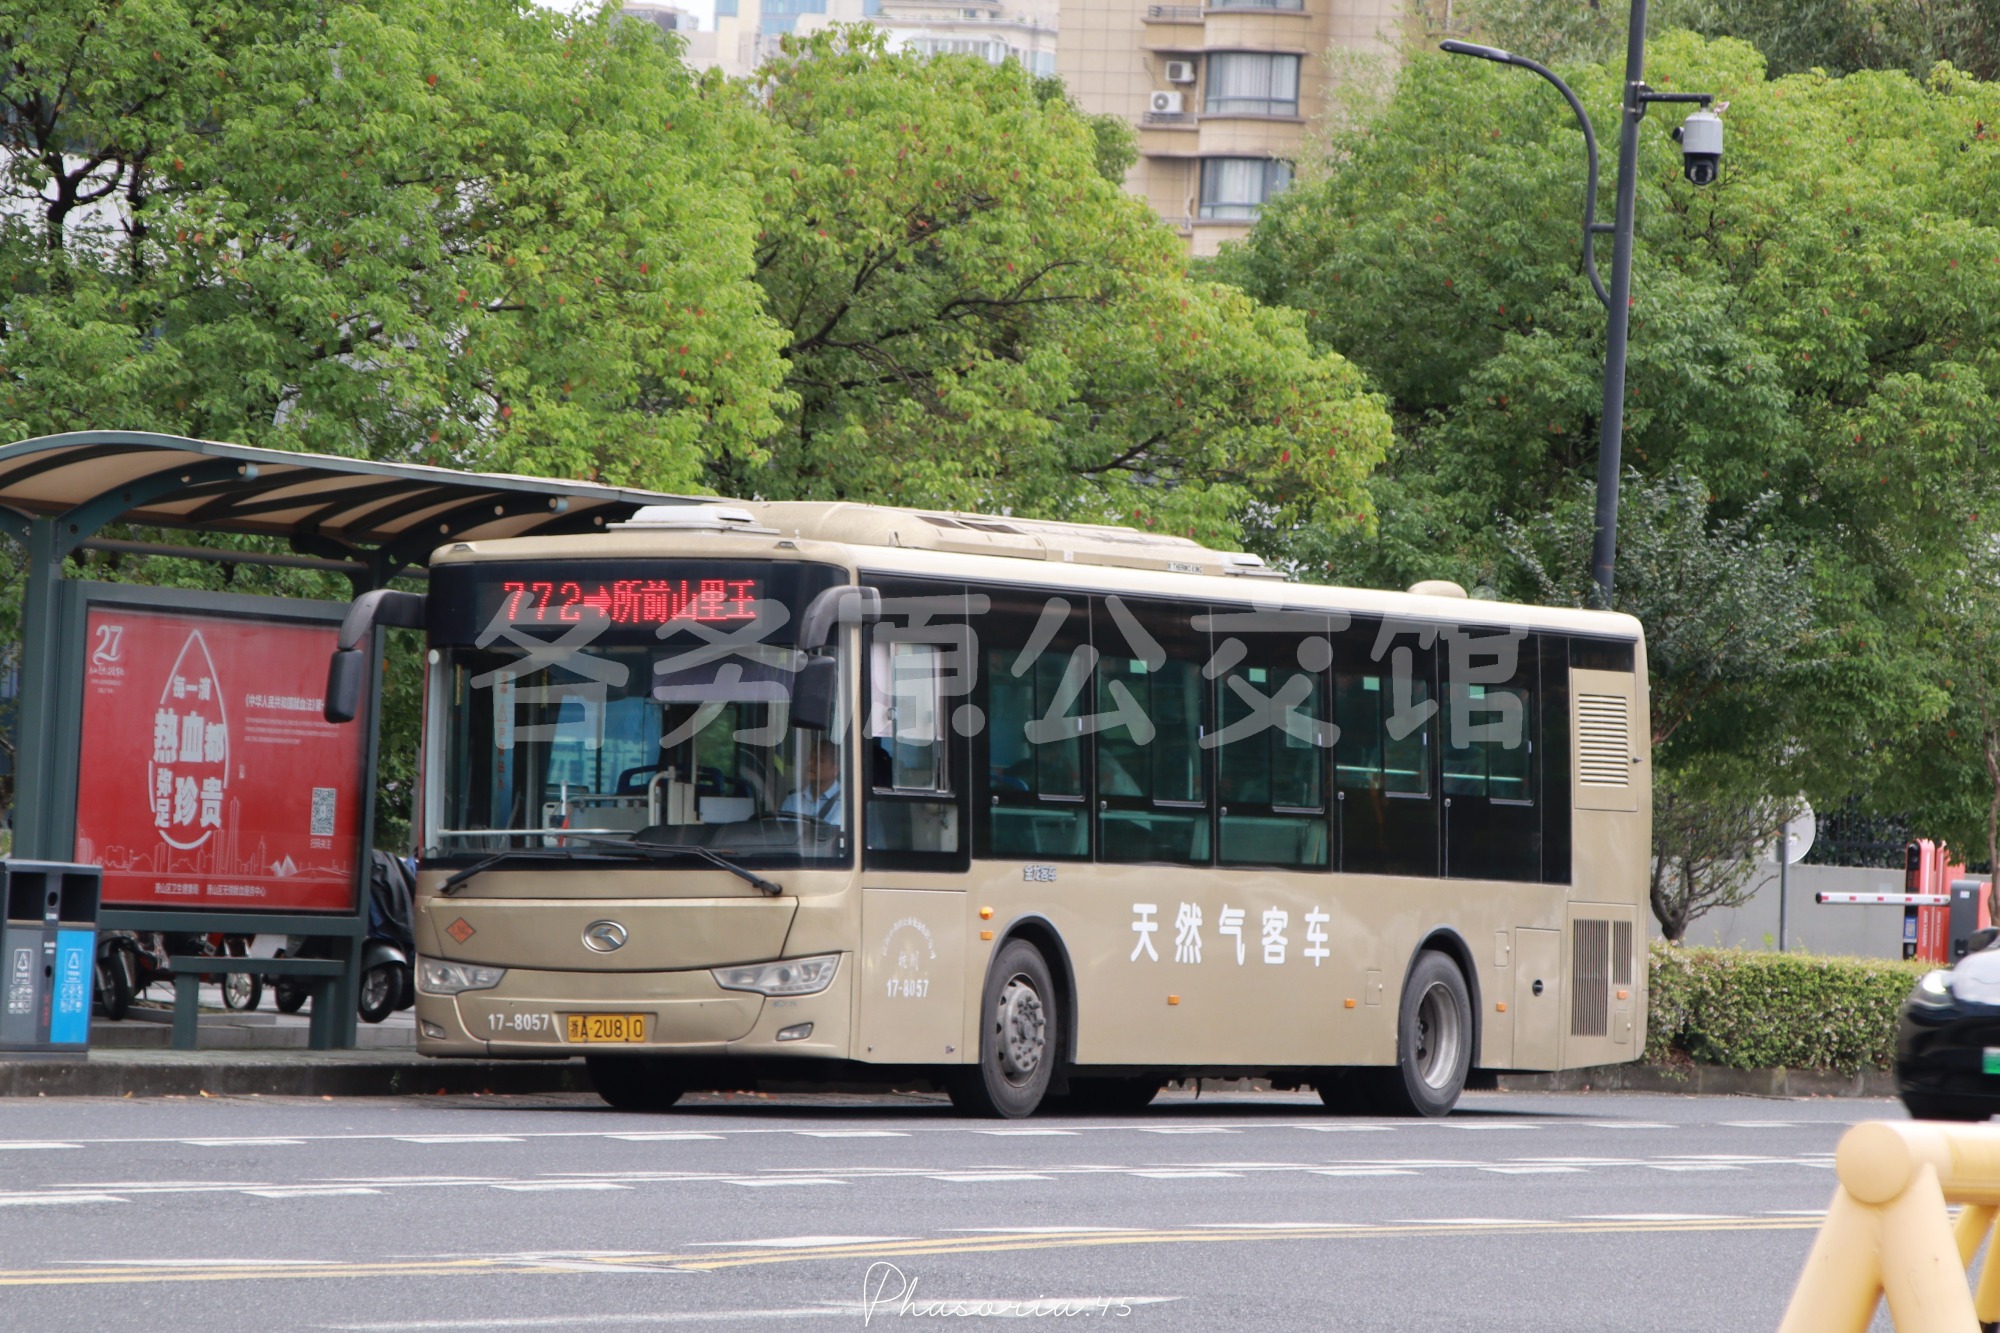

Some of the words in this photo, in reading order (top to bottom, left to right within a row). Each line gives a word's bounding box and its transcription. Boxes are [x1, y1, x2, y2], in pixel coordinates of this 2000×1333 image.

[504, 582, 582, 621] 772
[611, 579, 758, 623] 所前山里王
[92, 625, 123, 665] 27
[173, 675, 211, 700] 每一滴
[153, 707, 226, 764] 热血都
[1131, 902, 1331, 967] 天然气客车
[886, 978, 930, 998] 17-8057
[487, 1013, 550, 1031] 17-8057
